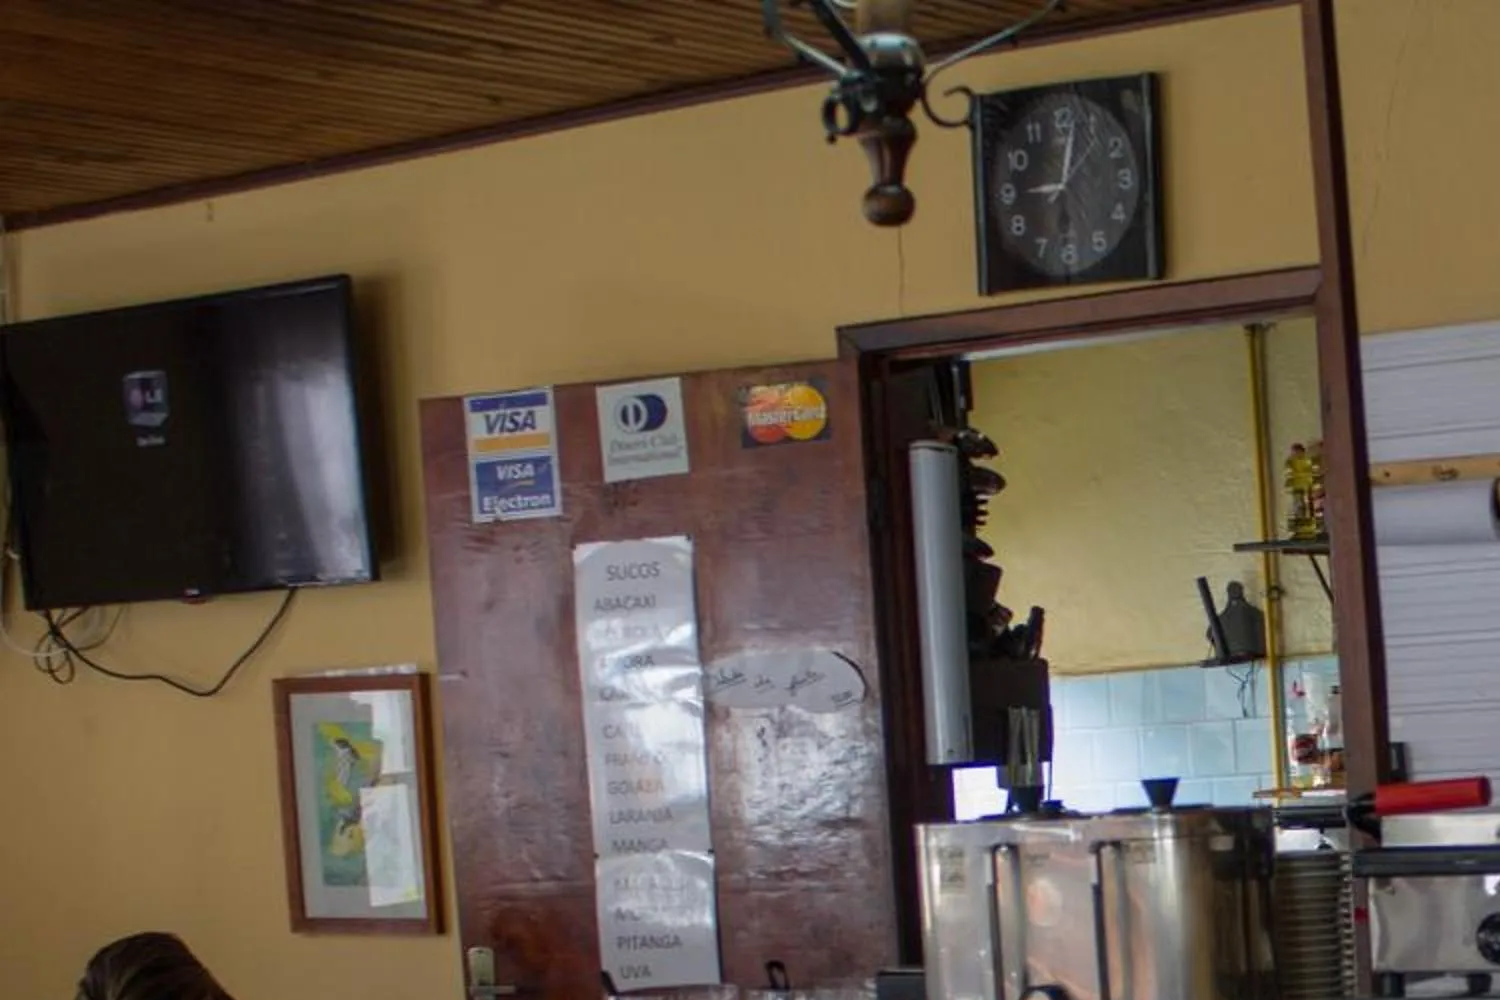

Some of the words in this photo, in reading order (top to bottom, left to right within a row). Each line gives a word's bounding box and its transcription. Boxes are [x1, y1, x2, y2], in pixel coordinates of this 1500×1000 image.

[1026, 122, 1042, 143] 11
[1109, 137, 1123, 158] 2
[1007, 149, 1030, 171] 10
[1117, 168, 1133, 189] 3
[1000, 183, 1016, 205] 9
[1111, 202, 1126, 222] 4
[1011, 215, 1025, 236] 8
[1035, 238, 1049, 257] 7
[1092, 232, 1106, 251] 5
[1061, 245, 1078, 264] 6
[484, 410, 537, 434] VISA
[496, 464, 535, 480] VISA
[483, 495, 552, 513] Electron
[606, 562, 661, 582] SUCOS
[616, 935, 683, 950] PITANGA
[619, 966, 651, 980] UVA
